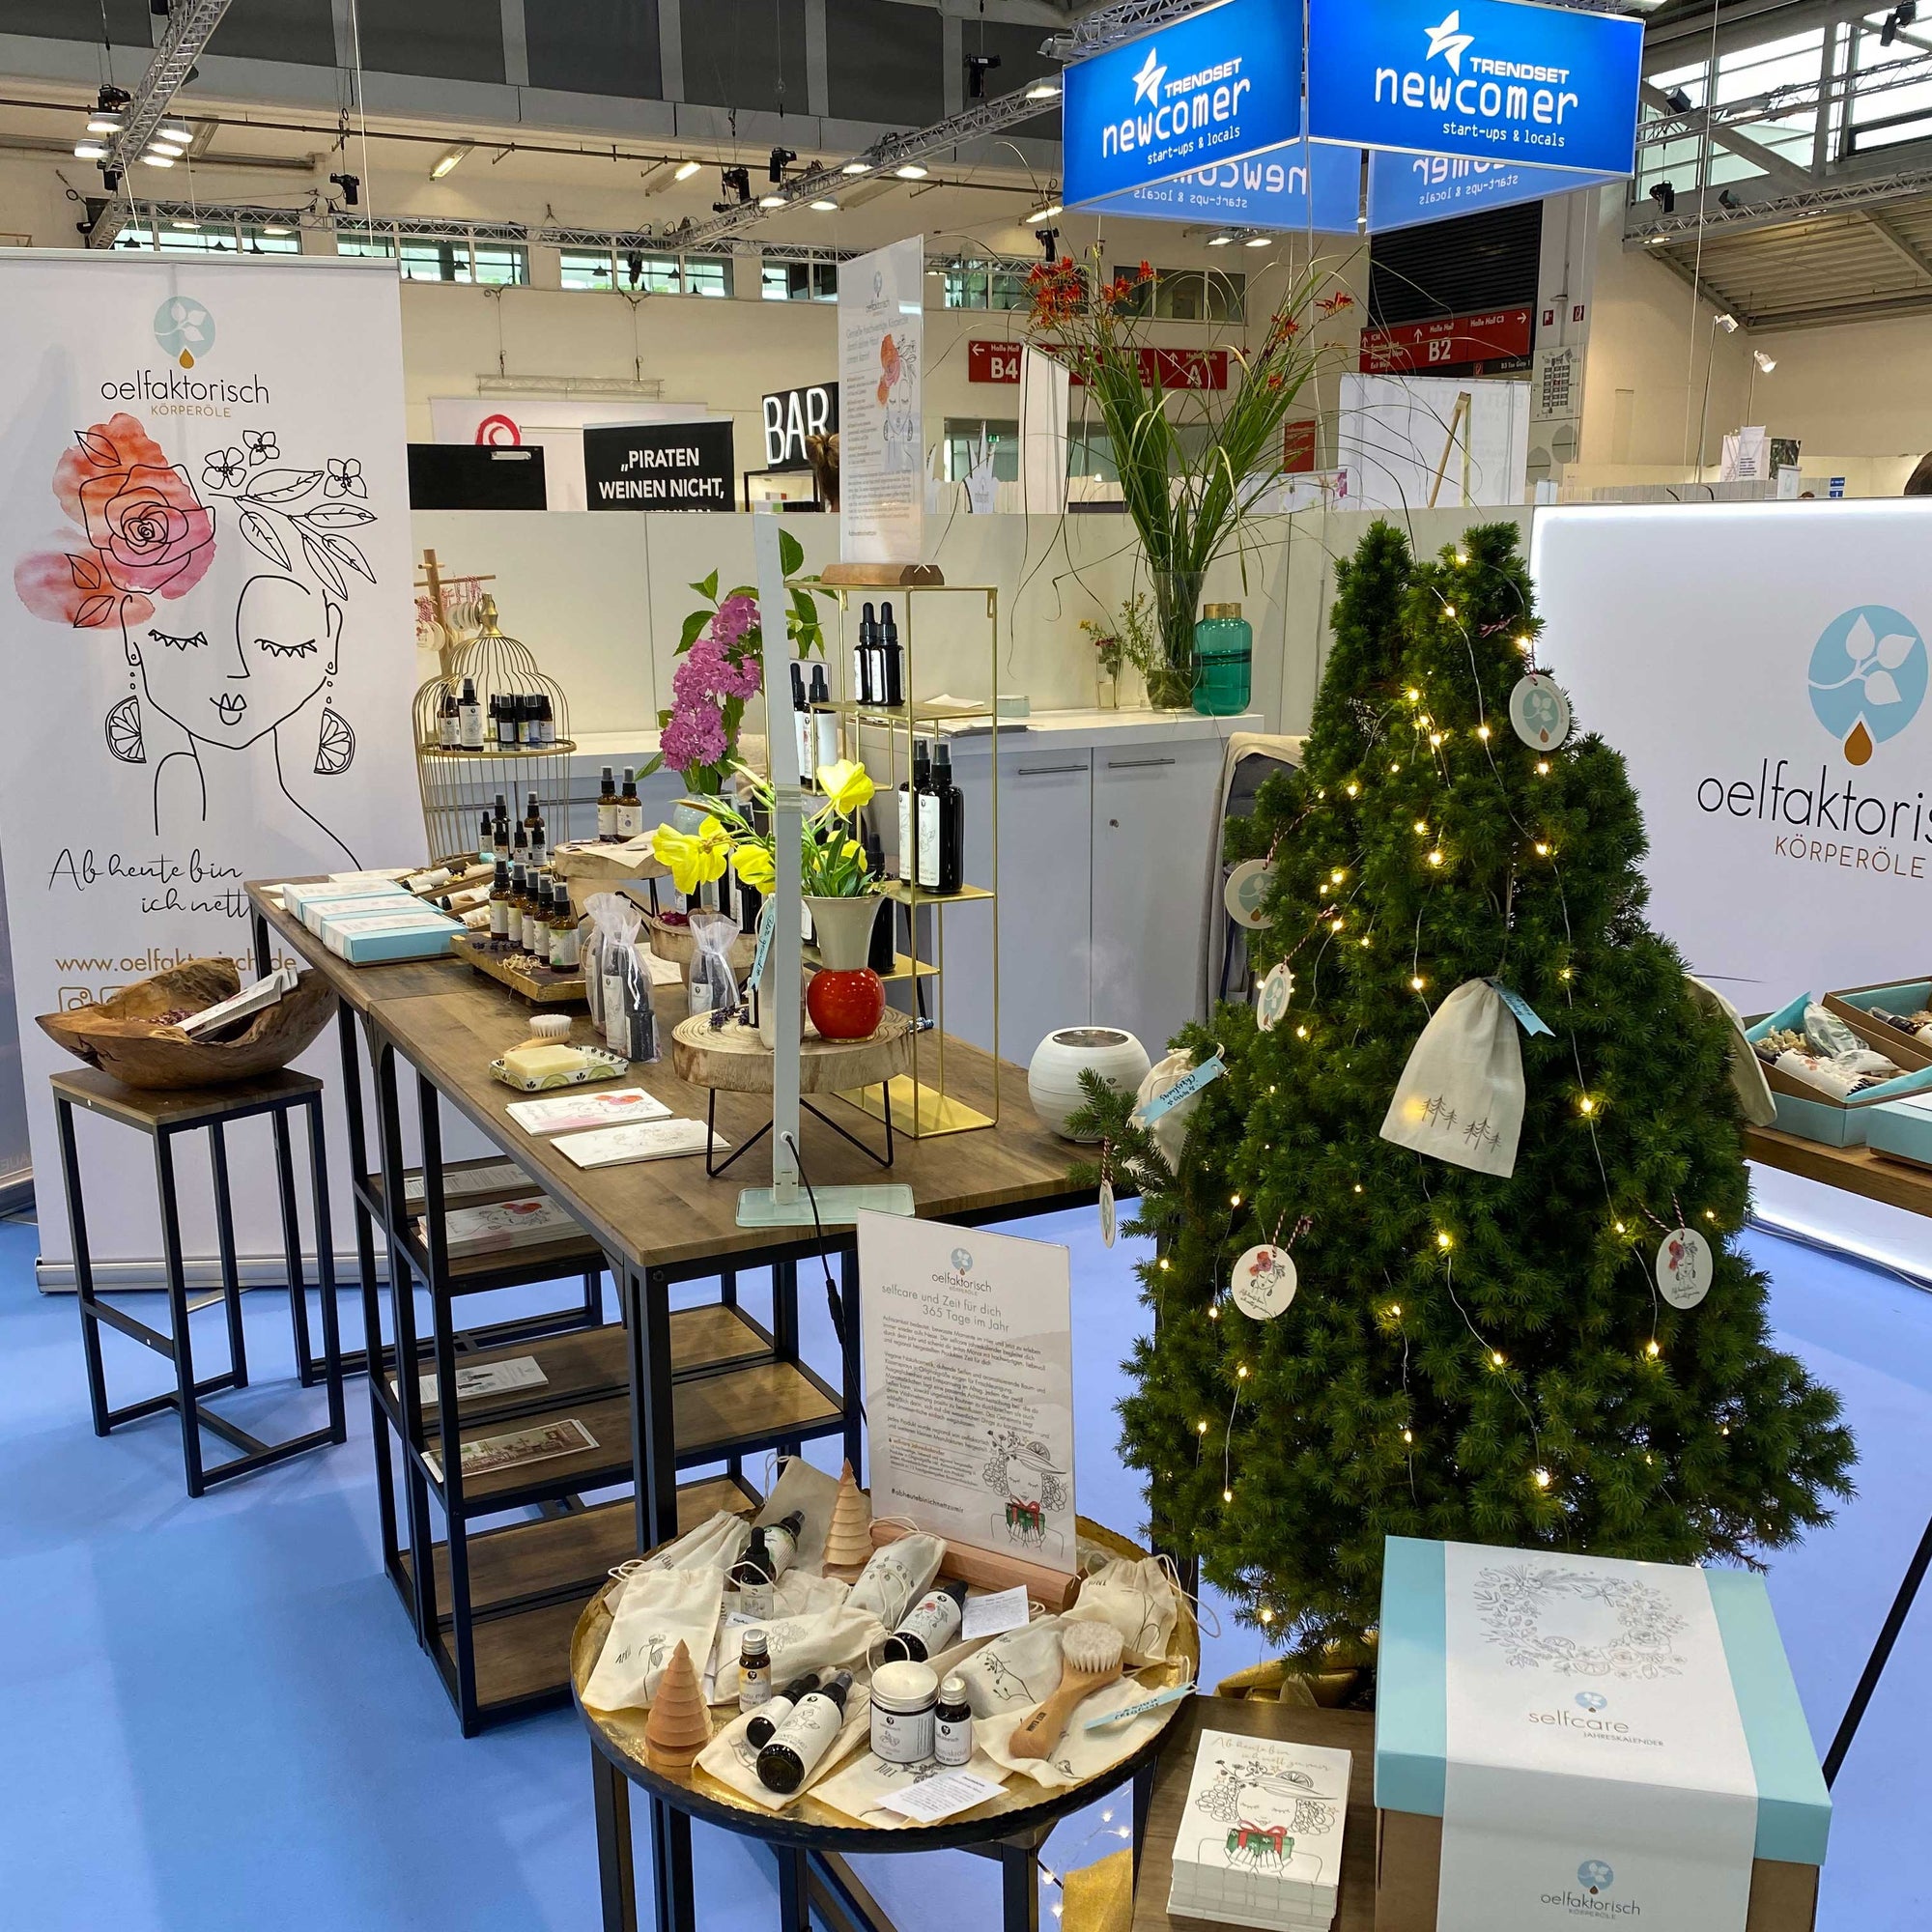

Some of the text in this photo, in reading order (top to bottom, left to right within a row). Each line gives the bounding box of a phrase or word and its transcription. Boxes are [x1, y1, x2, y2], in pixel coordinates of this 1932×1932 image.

[1164, 57, 1242, 98] TRENDSET
[1469, 57, 1570, 85] TRENDSET
[1375, 67, 1579, 125] newcomer
[1102, 77, 1251, 158] newcomer
[1148, 126, 1240, 165] start-ups & locals
[1442, 121, 1565, 147] start-ups & locals
[1429, 339, 1451, 361] B2
[990, 357, 1018, 379] B4
[1186, 364, 1201, 385] A
[100, 369, 270, 404] oelfaktorisch
[151, 402, 232, 418] KÖRPERÖLE
[763, 387, 830, 465] BAR
[599, 477, 724, 499] WEINEN NICHT,
[1776, 833, 1926, 879] KÖRPERÖLE
[48, 848, 243, 891] Ab heute bin
[141, 888, 186, 913] ich
[931, 1272, 992, 1293] oelfaktorisch
[882, 1284, 1002, 1318] selfcare und Zeit für dich
[922, 1304, 1009, 1333] 365 Tage im Jahr
[1528, 1709, 1629, 1733] selfcare
[1583, 1732, 1664, 1747] JAHRESKALENDER
[873, 1762, 898, 1777] JULI
[1540, 1890, 1640, 1916] oelfaktorisch
